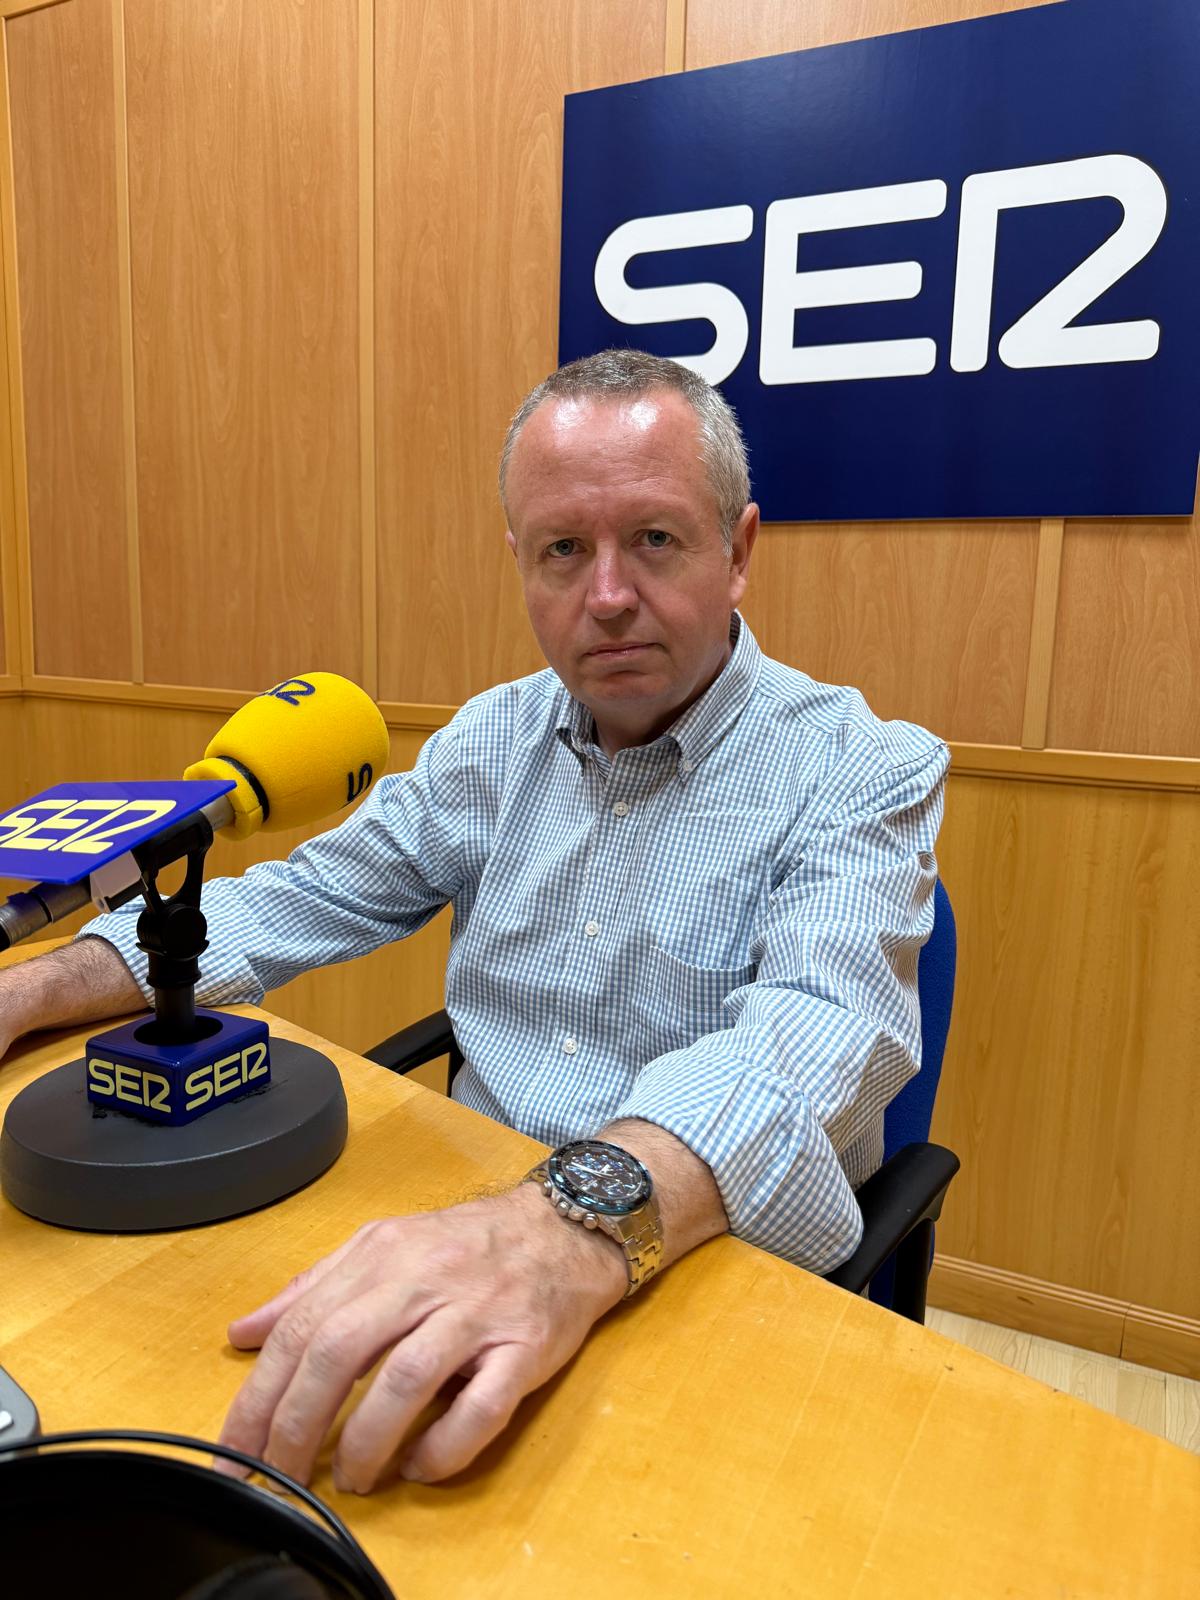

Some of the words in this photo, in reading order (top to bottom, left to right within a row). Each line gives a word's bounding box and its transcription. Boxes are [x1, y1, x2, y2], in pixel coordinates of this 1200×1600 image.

[594, 154, 1168, 386] SER
[0, 799, 177, 854] SER
[88, 1058, 172, 1113] SER
[185, 1042, 268, 1112] SER
